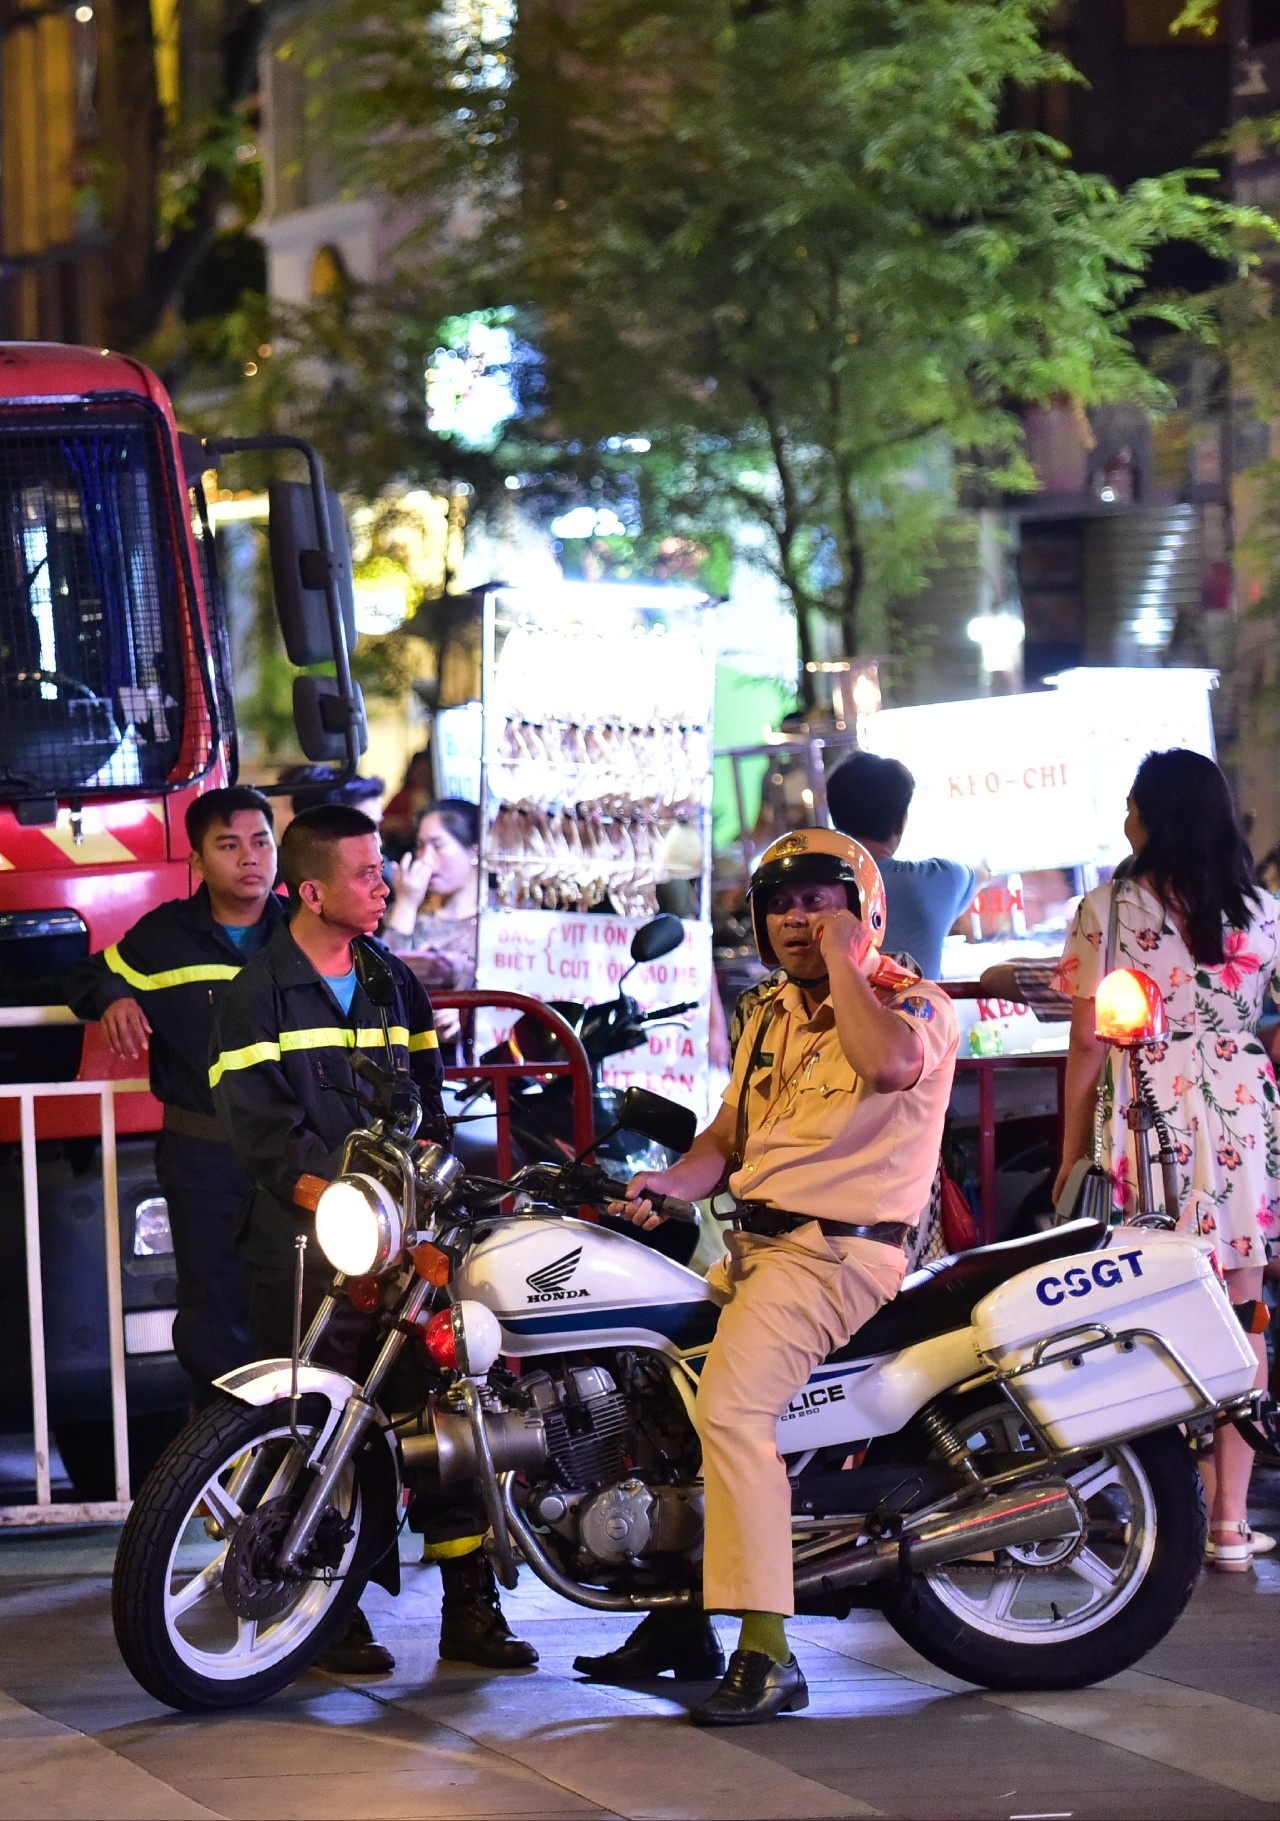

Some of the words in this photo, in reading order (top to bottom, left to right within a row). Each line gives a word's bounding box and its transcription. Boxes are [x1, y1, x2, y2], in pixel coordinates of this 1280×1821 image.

[1035, 1249, 1144, 1307] CSGT
[526, 1288, 591, 1304] HONDA
[786, 1383, 846, 1413] LICE
[780, 1413, 797, 1422] CB
[798, 1407, 821, 1418] 250
